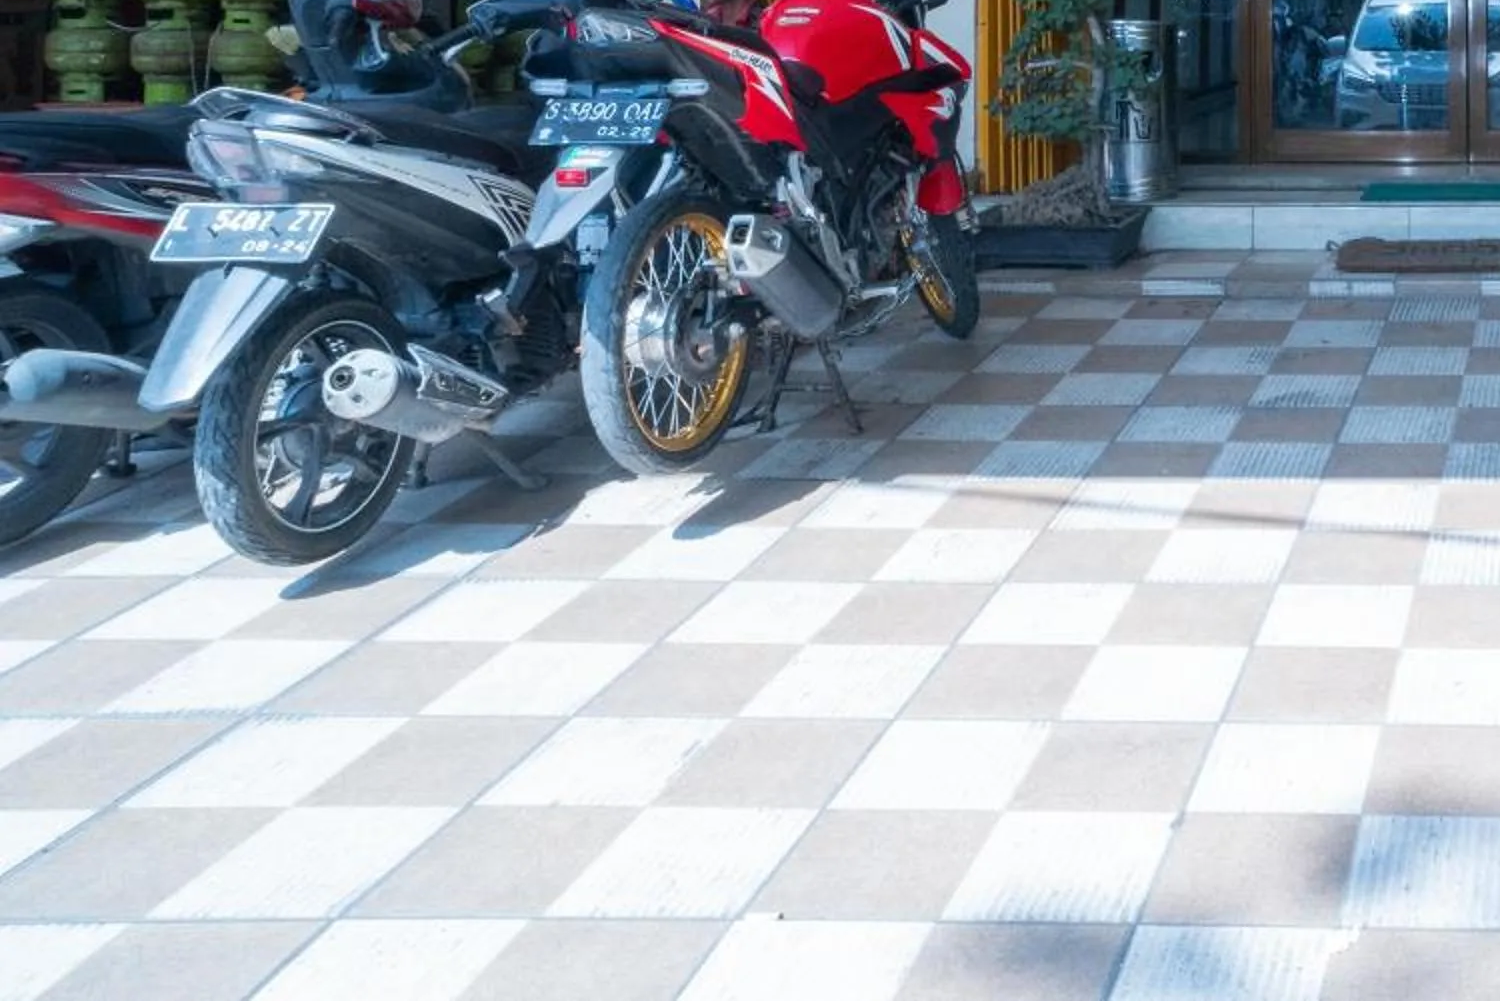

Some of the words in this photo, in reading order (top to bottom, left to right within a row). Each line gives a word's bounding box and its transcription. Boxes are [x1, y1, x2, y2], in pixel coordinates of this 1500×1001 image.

[171, 209, 190, 231] L
[212, 209, 276, 232] 5487
[287, 210, 327, 231] ZT
